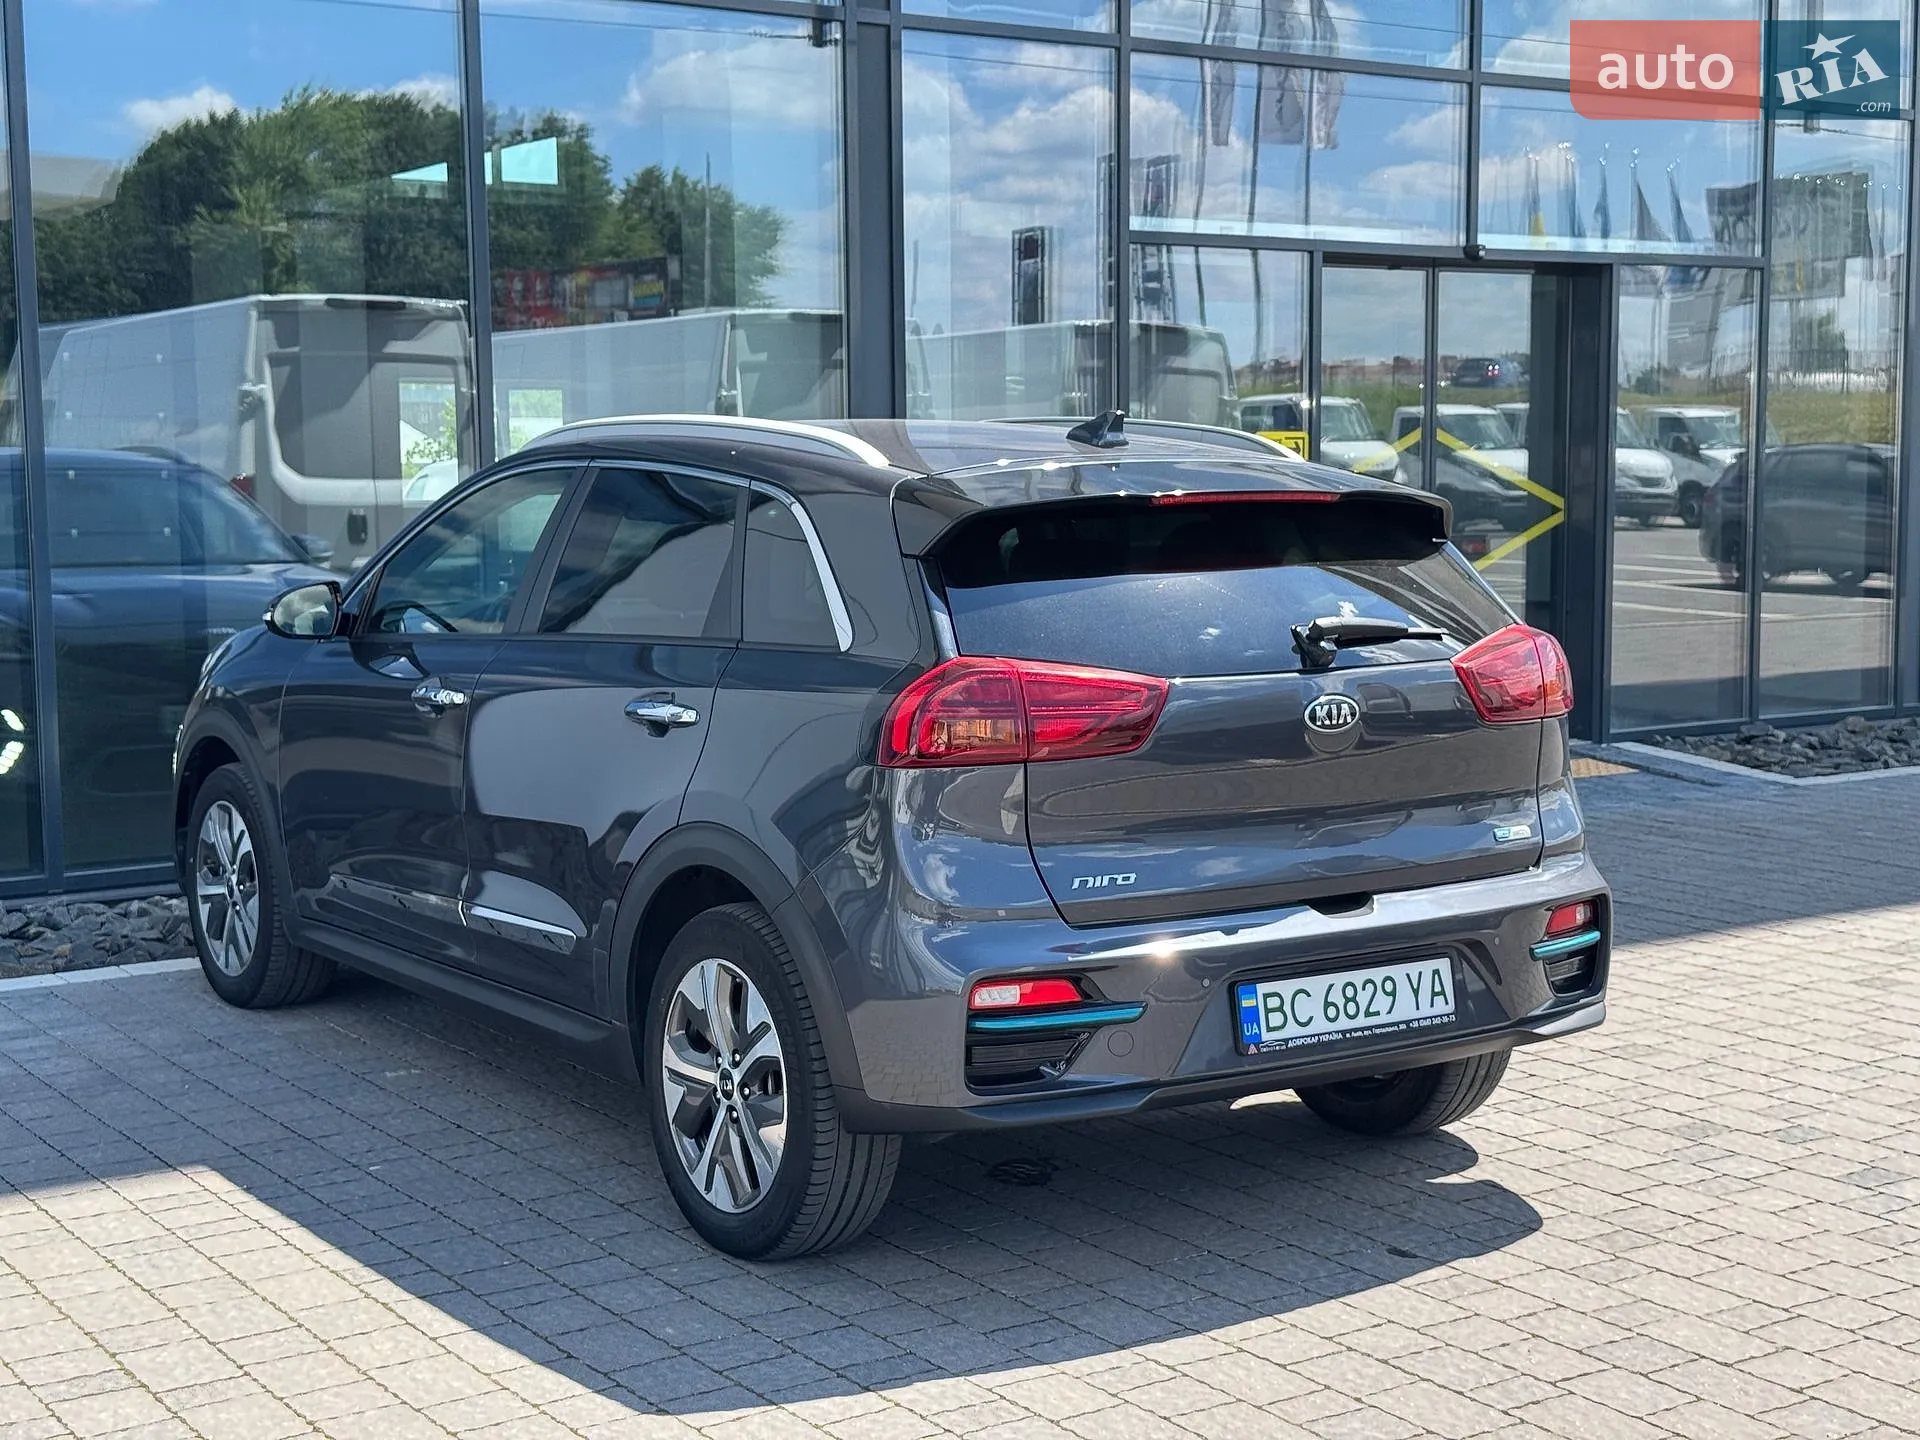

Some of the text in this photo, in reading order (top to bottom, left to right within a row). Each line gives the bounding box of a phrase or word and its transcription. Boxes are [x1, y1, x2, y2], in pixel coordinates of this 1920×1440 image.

[1315, 703, 1352, 726] KIA
[1262, 967, 1450, 1033] BC 6829 YA
[1243, 1021, 1260, 1036] UA
